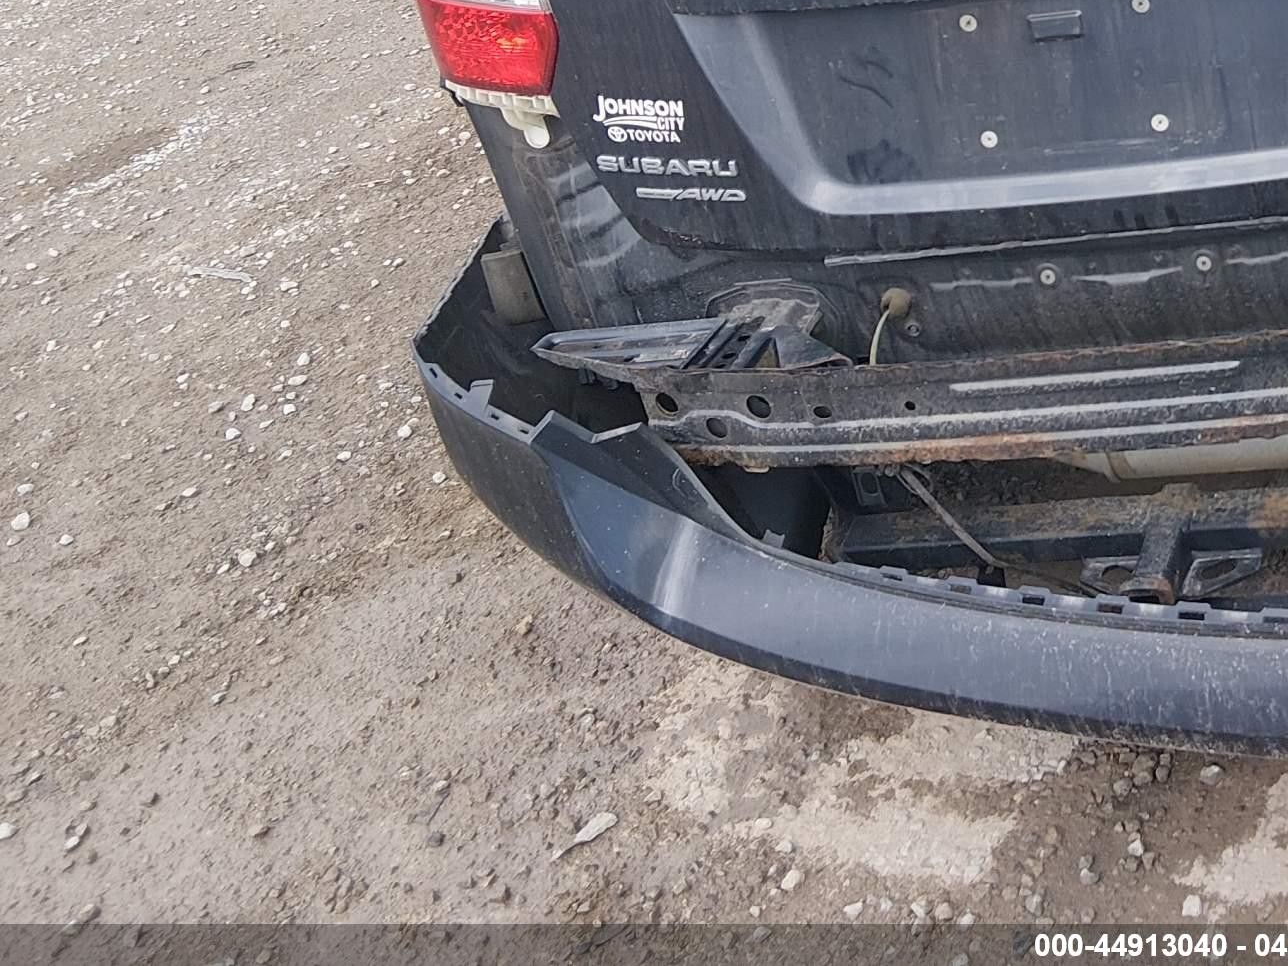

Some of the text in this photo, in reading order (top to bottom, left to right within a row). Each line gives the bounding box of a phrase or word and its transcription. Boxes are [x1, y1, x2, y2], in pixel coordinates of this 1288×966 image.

[656, 116, 686, 131] CITY
[626, 129, 681, 143] TOYOTA
[596, 154, 739, 178] SUBARU
[675, 187, 747, 202] AWD
